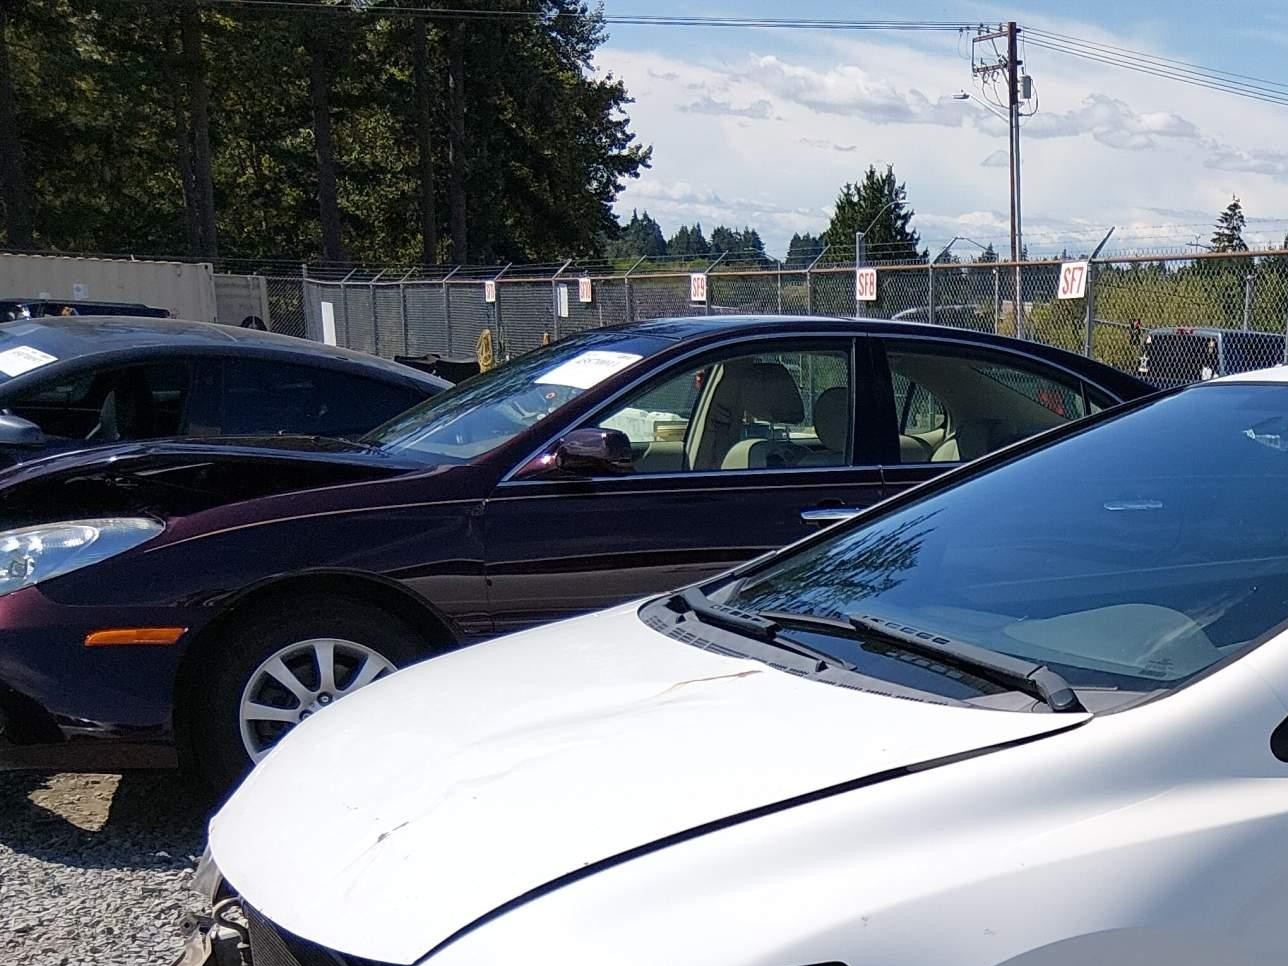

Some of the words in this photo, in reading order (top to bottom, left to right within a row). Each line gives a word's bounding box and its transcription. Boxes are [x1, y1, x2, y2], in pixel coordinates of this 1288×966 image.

[692, 276, 706, 297] SF9
[858, 272, 876, 297] SF8
[1062, 267, 1085, 295] SF7
